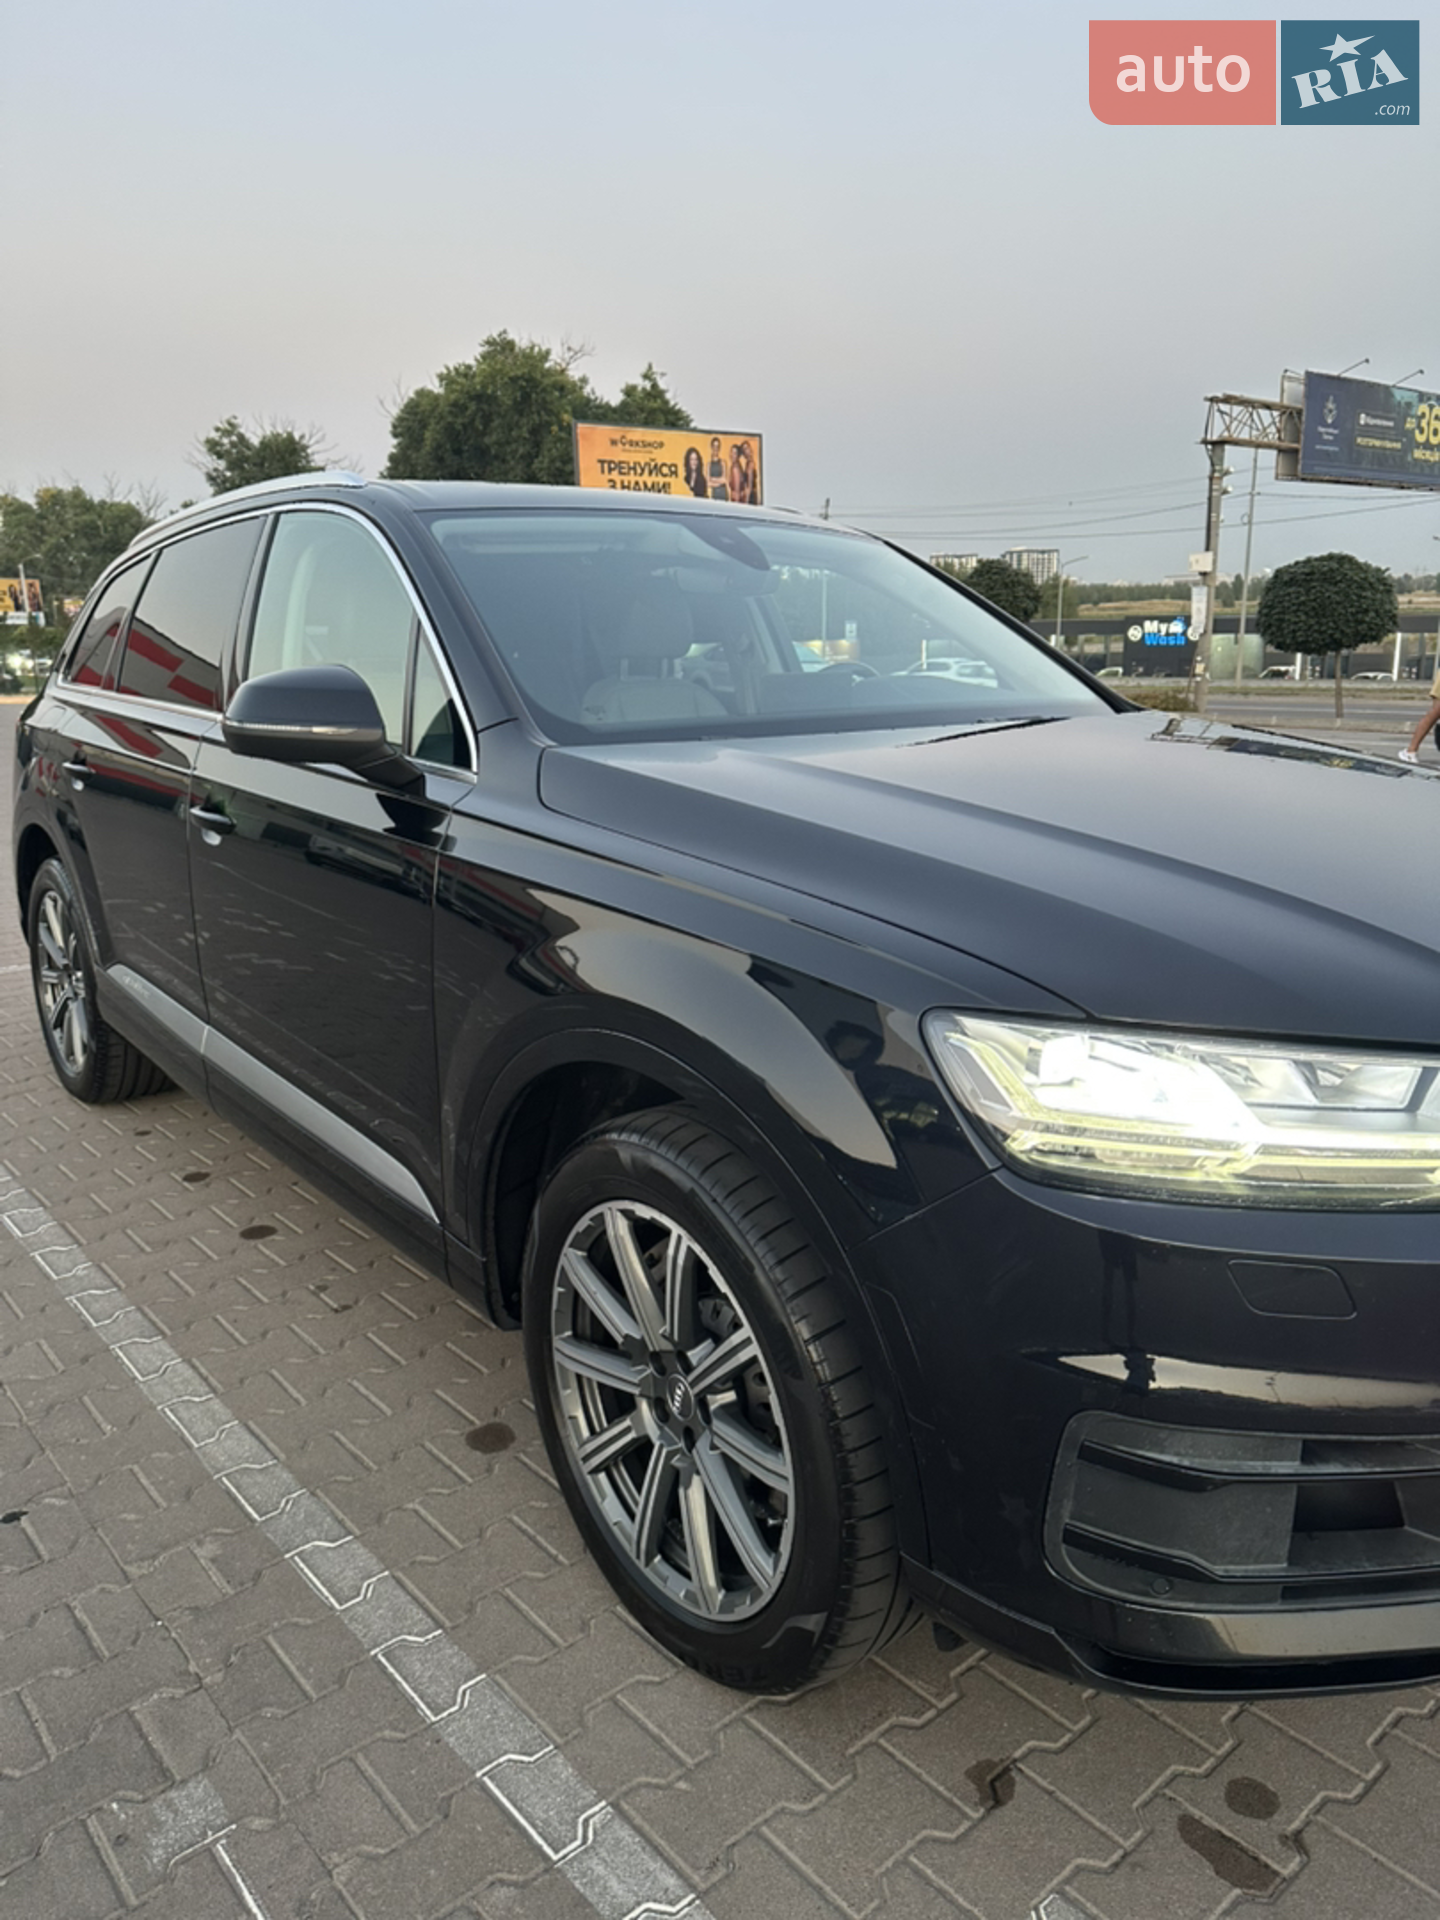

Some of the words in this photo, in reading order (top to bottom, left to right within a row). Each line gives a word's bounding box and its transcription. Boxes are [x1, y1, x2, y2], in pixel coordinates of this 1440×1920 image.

[597, 458, 679, 479] ТРЕНУЙСЯ
[1143, 620, 1169, 636] My
[1144, 632, 1185, 646] Wash
